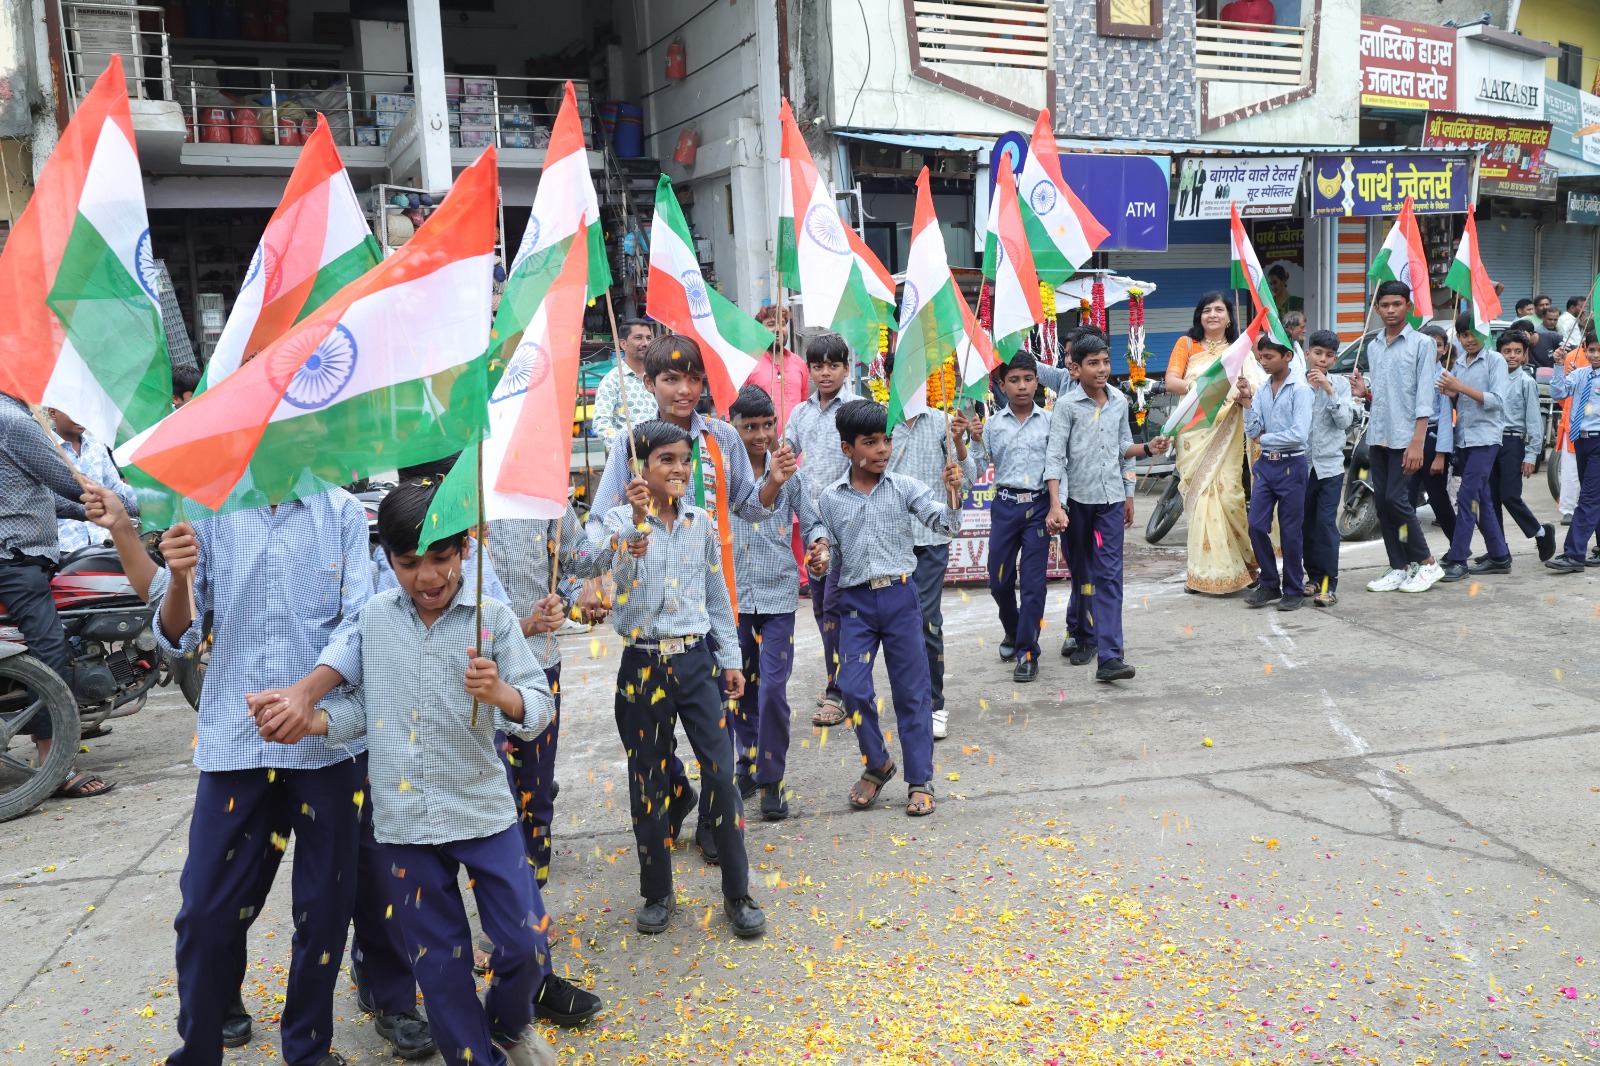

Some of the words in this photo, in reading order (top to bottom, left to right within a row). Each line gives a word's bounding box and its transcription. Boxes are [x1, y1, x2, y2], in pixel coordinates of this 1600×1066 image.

[1417, 37, 1453, 66] हाउस
[1366, 66, 1415, 97] जनरल
[1416, 66, 1448, 100] स्टोर
[1479, 77, 1539, 107] AAKASH
[1544, 93, 1577, 115] WESTERN
[1442, 118, 1474, 139] प्लास्टिक
[1474, 124, 1495, 141] हाउस
[1508, 127, 1532, 144] जनरल
[1532, 126, 1549, 145] स्टोर
[1210, 165, 1247, 182] बांगरोद
[1248, 165, 1270, 182] वाले
[1272, 164, 1299, 181] टेलर्स
[1356, 162, 1394, 202] पार्थ
[1395, 162, 1453, 200] ज्वेलर्स
[1247, 188, 1260, 202] सूट
[1125, 201, 1156, 218] ATM
[1256, 226, 1277, 244] पार्थ
